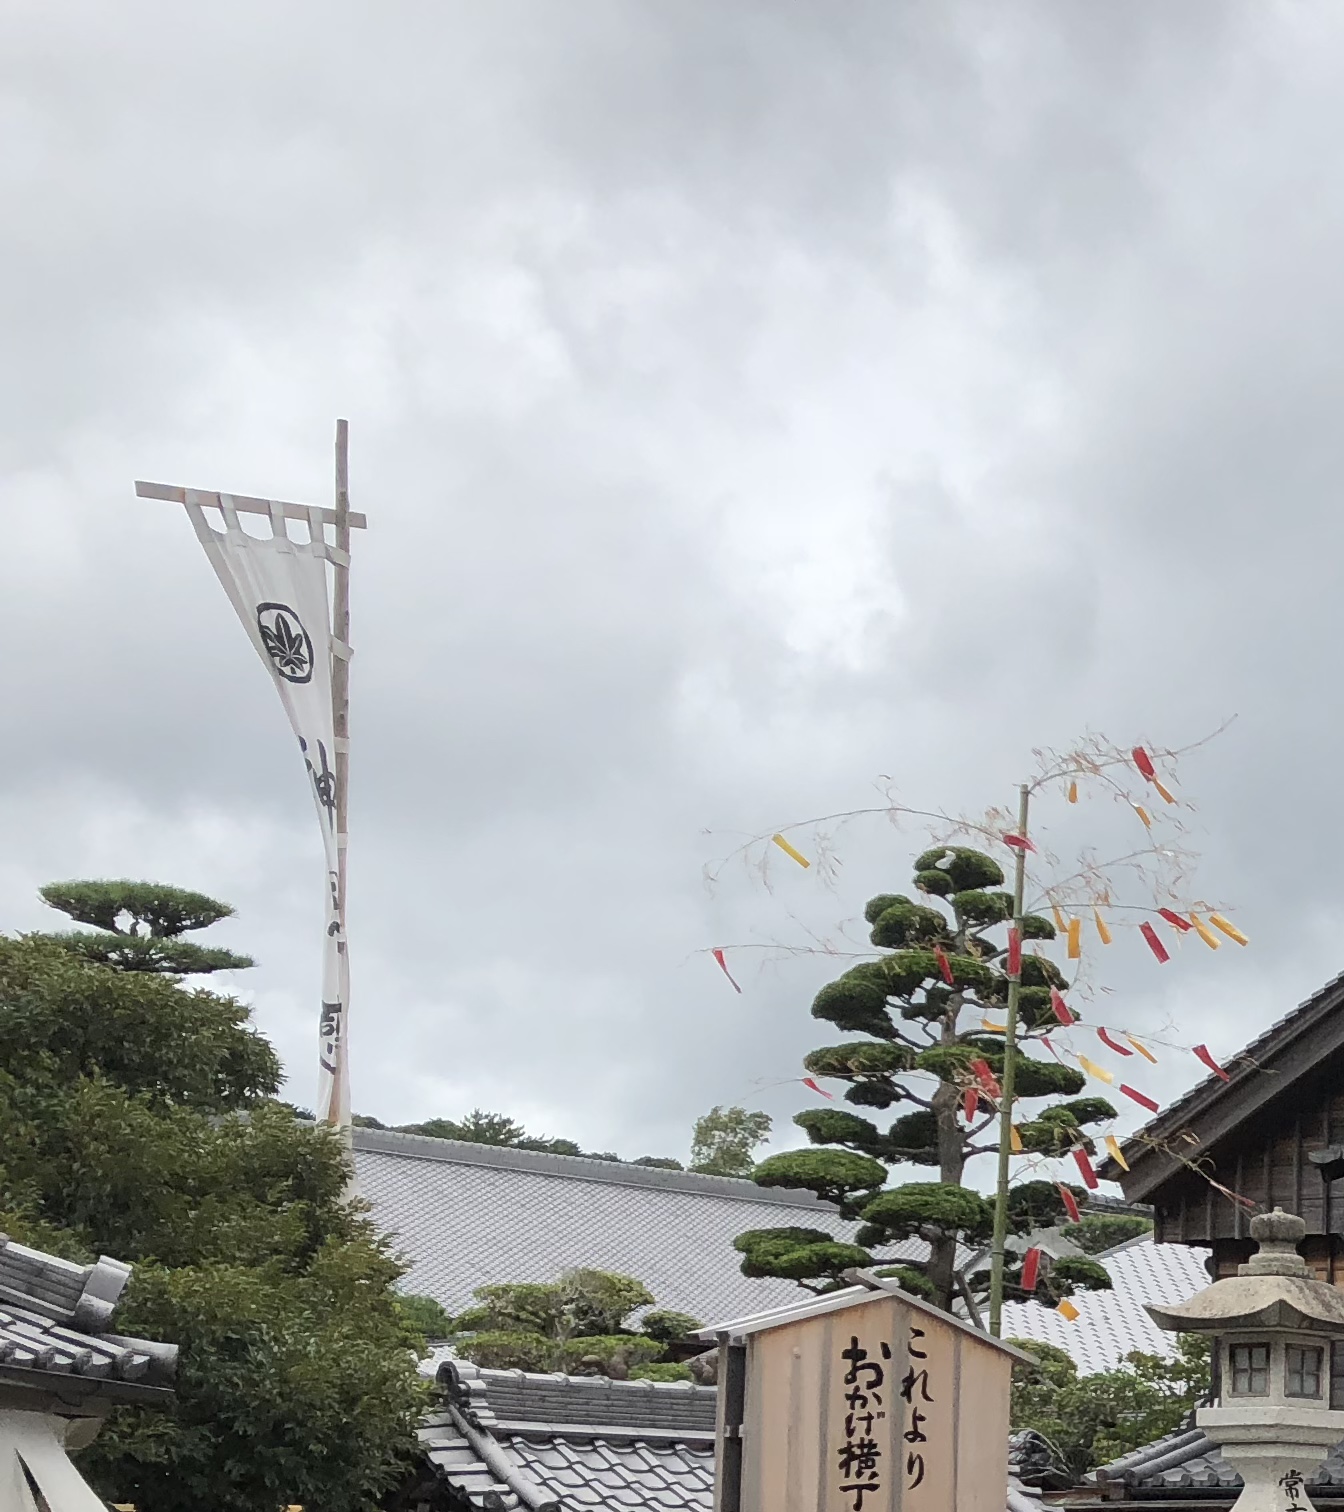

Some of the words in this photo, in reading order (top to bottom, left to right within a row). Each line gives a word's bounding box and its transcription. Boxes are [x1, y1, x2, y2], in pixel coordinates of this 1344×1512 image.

[837, 1335, 892, 1512] おかげ横丁
[899, 1326, 935, 1491] これより
